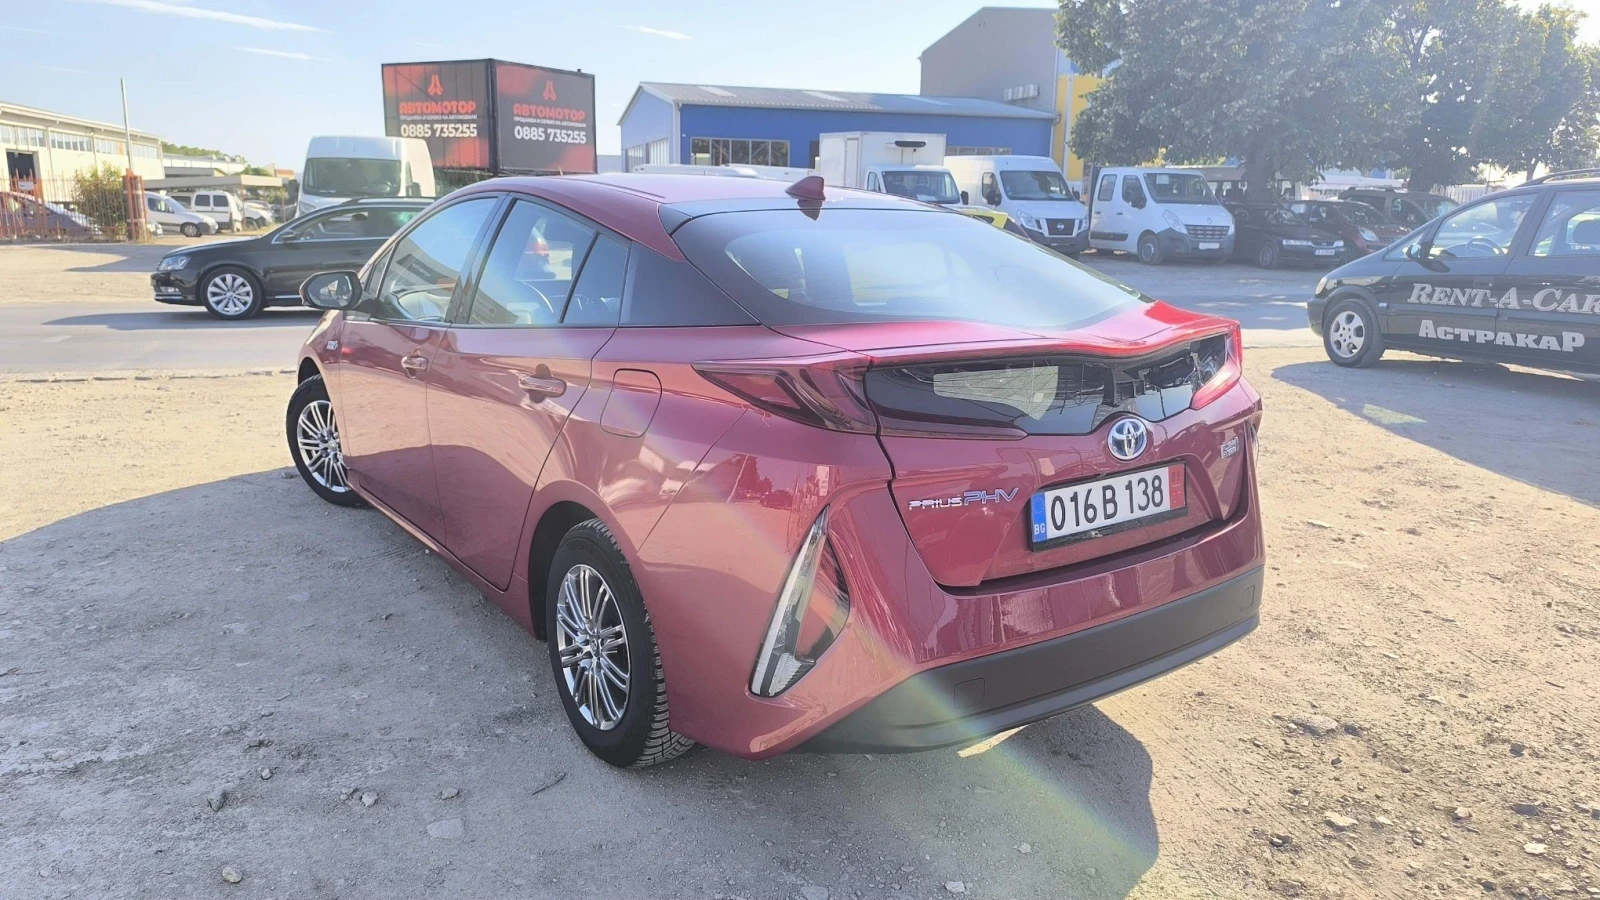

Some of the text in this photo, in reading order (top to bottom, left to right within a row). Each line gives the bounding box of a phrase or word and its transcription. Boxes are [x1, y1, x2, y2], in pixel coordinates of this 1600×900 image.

[399, 101, 476, 114] АВТОМОТОР
[513, 103, 586, 122] АВТОМОТОР
[401, 123, 478, 138] 0885 735255
[514, 125, 587, 145] 0885 735255
[909, 487, 1019, 511] PRIUS PHV
[1034, 522, 1046, 535] BG
